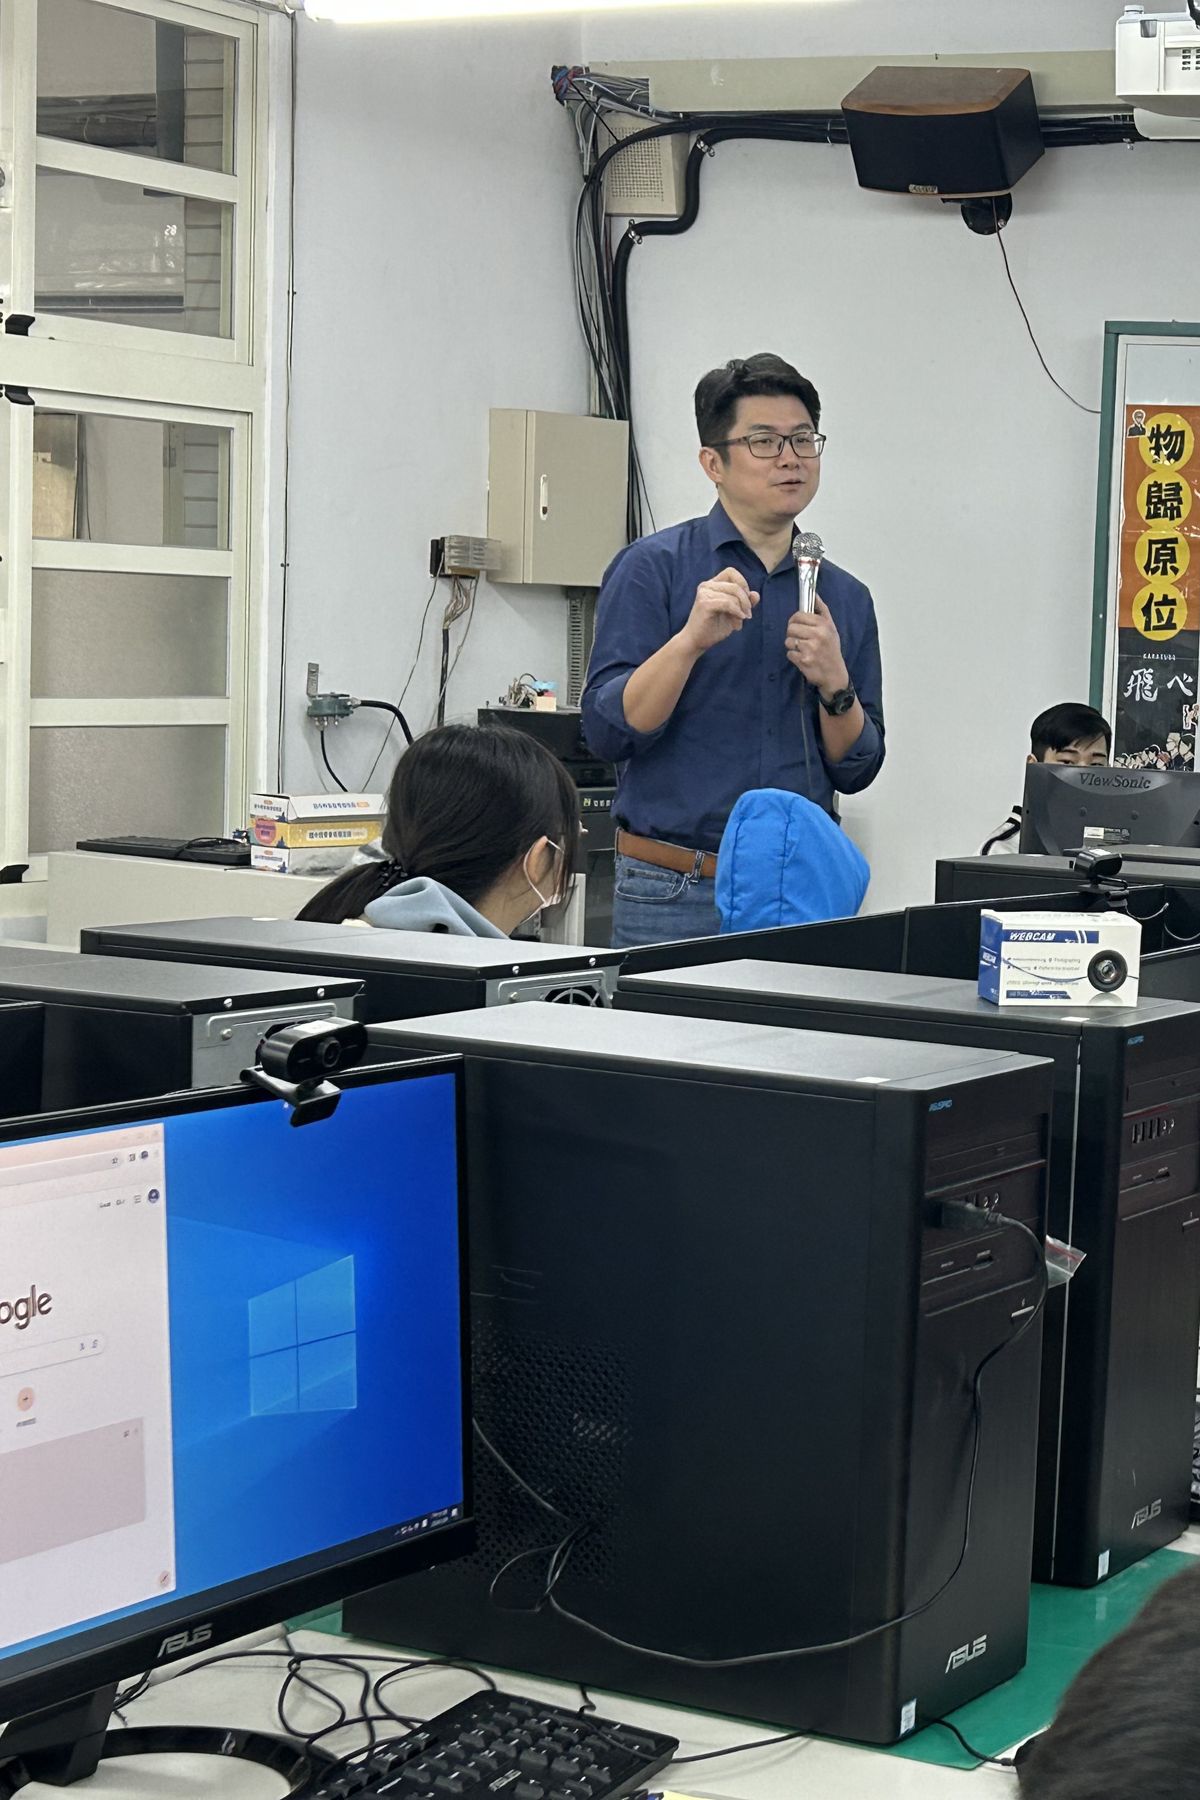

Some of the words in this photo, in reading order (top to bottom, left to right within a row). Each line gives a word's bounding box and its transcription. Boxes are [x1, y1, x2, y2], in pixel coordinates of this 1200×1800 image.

[1140, 424, 1186, 632] 物歸原位
[1009, 932, 1057, 941] WEBCAM
[157, 1623, 213, 1658] ASUS
[945, 1634, 987, 1674] ASUS
